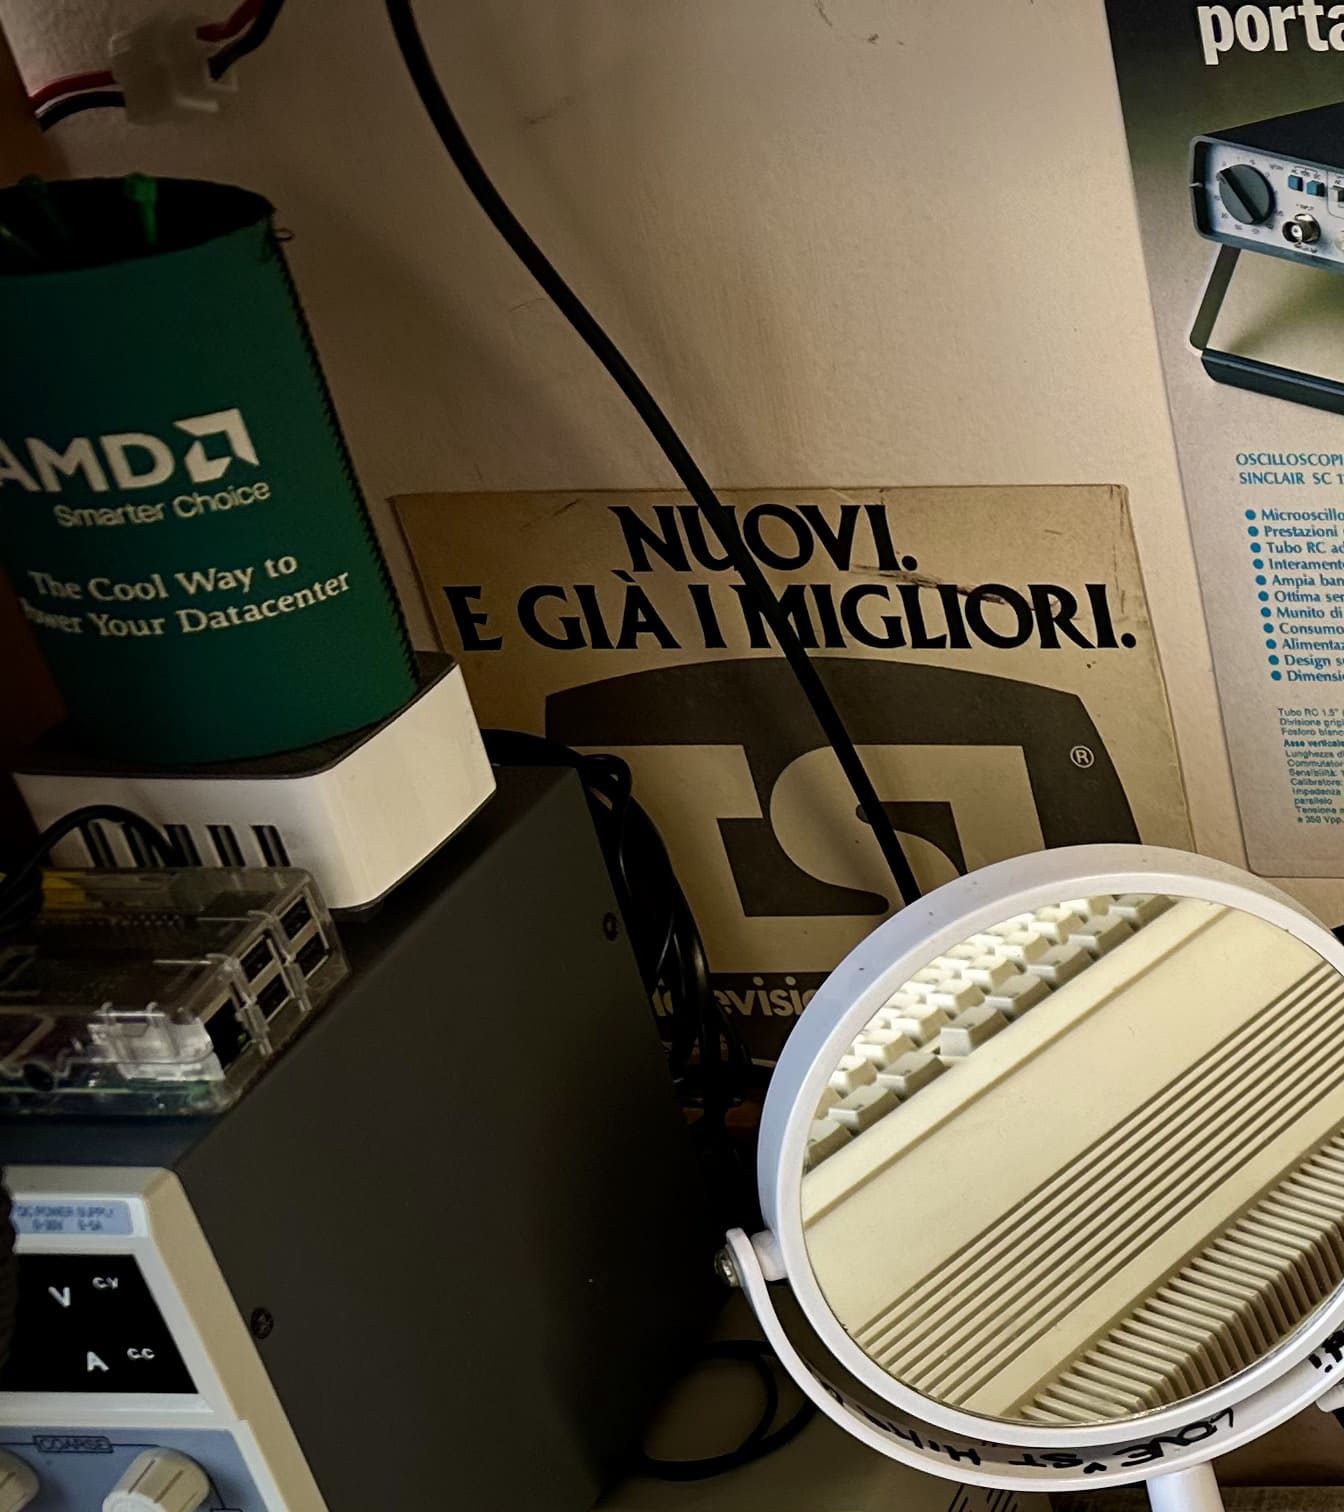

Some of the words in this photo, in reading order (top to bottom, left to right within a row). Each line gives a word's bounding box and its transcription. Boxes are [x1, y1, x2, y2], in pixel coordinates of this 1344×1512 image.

[0, 432, 175, 492] AMD
[1239, 472, 1305, 485] SINCLAIR
[1313, 472, 1332, 485] SC
[54, 500, 165, 527] Smarter
[172, 482, 271, 518] Choice
[608, 504, 919, 573] NUOVI.
[1264, 525, 1339, 538] Prestazioni
[1266, 542, 1302, 554] Tubo
[1307, 542, 1326, 554] RC
[27, 570, 82, 600] The
[86, 573, 168, 602] Cool
[174, 566, 254, 595] Way
[264, 555, 297, 580] to
[1272, 575, 1316, 590] Ampia
[87, 612, 165, 638] Your
[175, 571, 350, 634] Datacenter
[1274, 590, 1320, 602] Ottima
[442, 584, 504, 652] E
[516, 571, 683, 650] GIÀ
[694, 584, 727, 650] I
[731, 583, 1138, 651] MIGLIORI.
[1277, 606, 1325, 619] Munito
[1330, 605, 1343, 619] di
[1279, 623, 1344, 635] Consumo
[1284, 655, 1331, 669] Design
[48, 1286, 72, 1308] V
[86, 1351, 109, 1372] A
